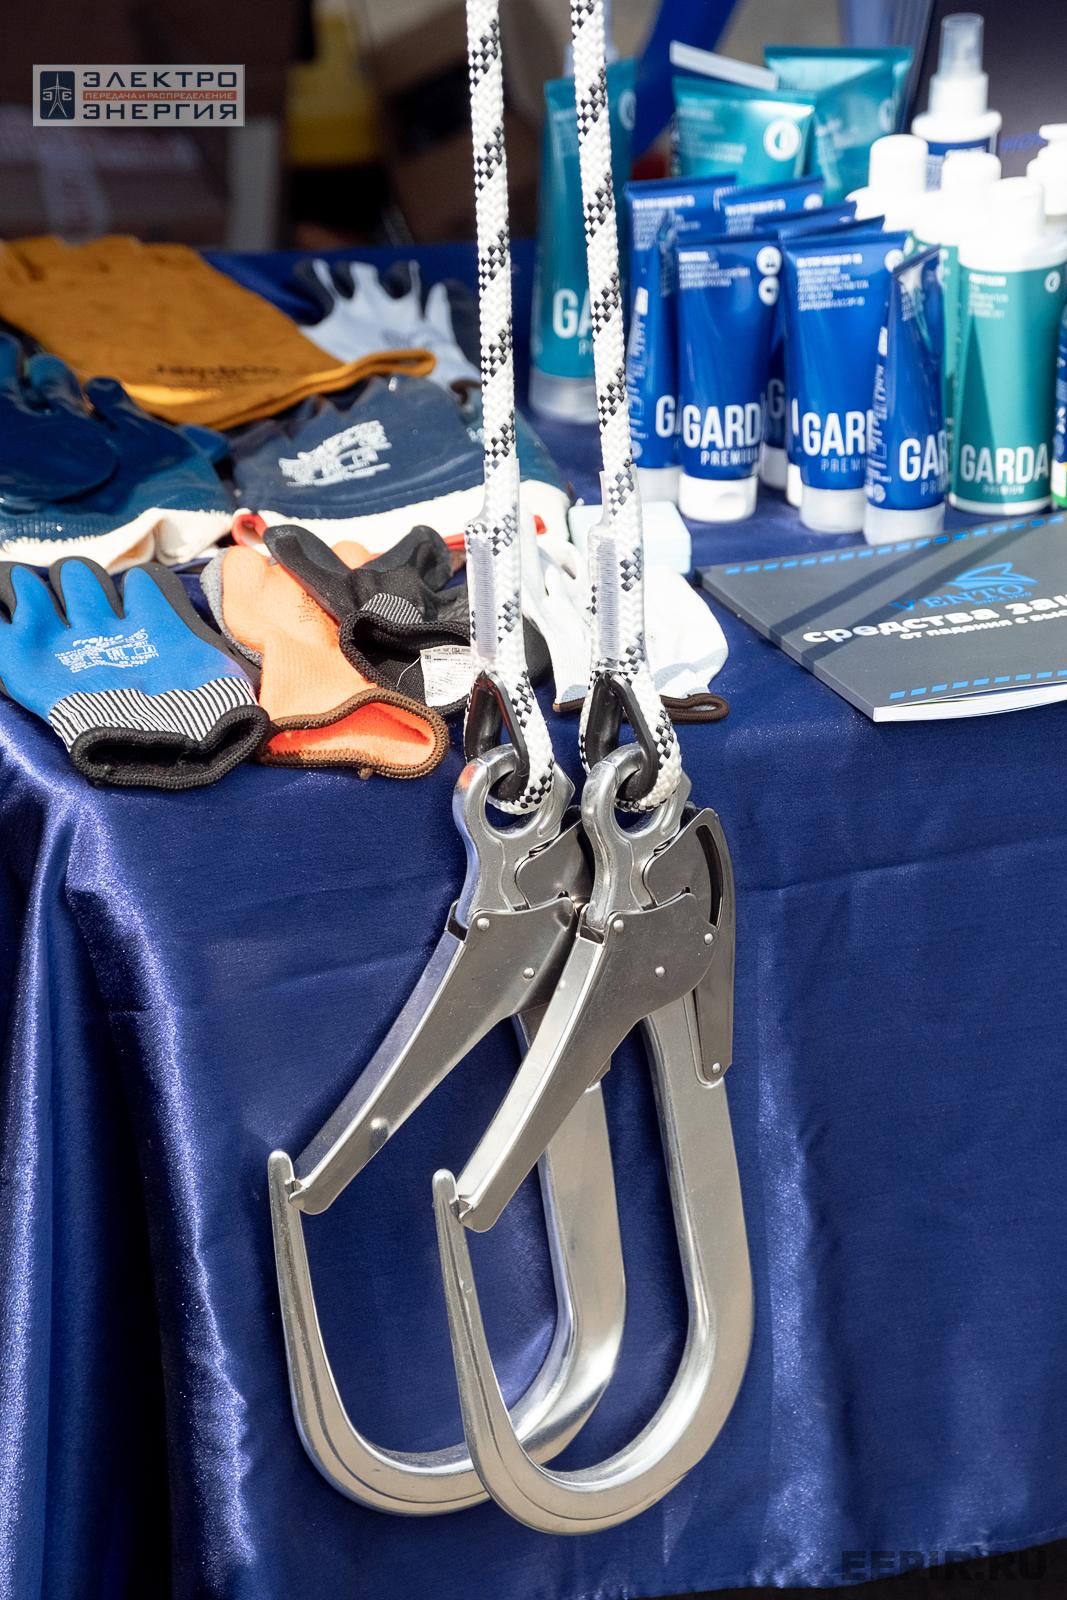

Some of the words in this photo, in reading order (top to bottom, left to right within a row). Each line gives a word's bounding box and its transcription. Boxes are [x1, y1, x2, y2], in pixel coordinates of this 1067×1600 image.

[683, 402, 765, 449] GARD
[802, 409, 875, 456] GAR
[899, 429, 949, 481] GAR
[960, 443, 1049, 484] GARDA
[889, 584, 1025, 611] VENTO
[802, 608, 1000, 642] средства
